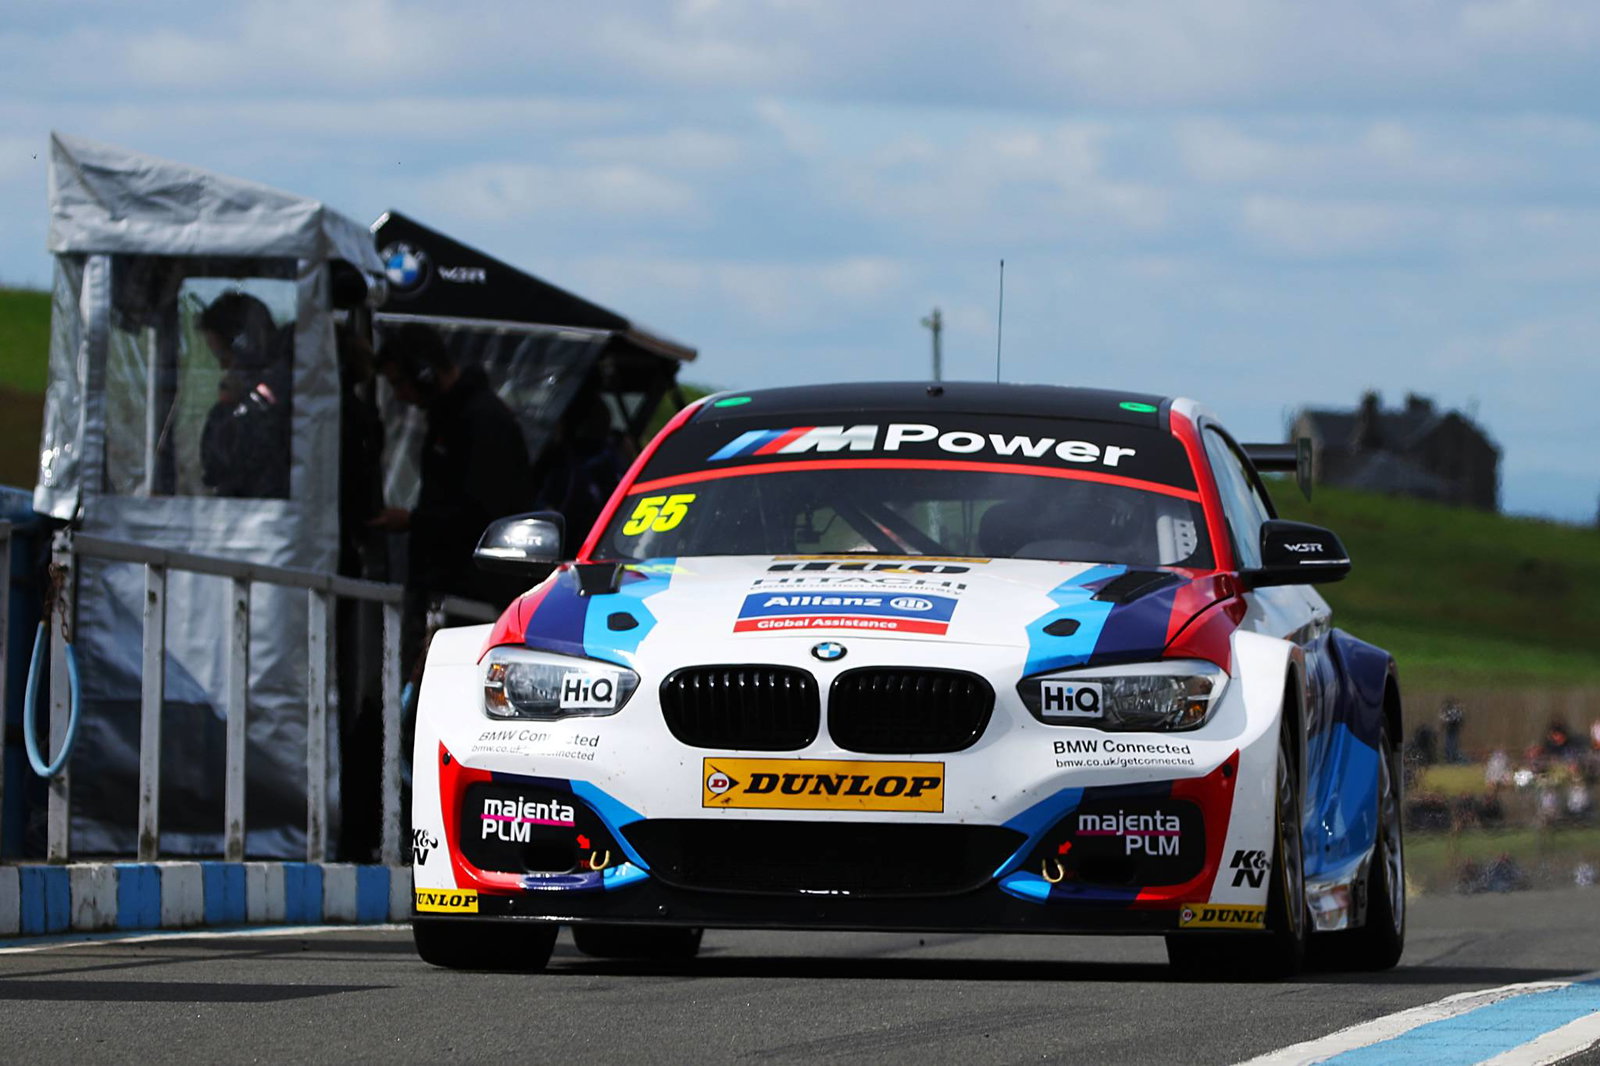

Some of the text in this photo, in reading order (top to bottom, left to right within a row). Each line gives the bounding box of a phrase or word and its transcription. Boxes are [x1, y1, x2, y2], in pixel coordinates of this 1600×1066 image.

[622, 494, 696, 535] 55
[1283, 543, 1324, 552] WSR
[763, 596, 883, 607] Allianz
[757, 618, 898, 629] Global Assistance
[564, 678, 613, 703] HiQ
[1044, 686, 1100, 713] HiQ
[478, 730, 517, 742] BMW
[1053, 739, 1191, 754] BMW Connected
[1056, 757, 1195, 768] bmw.co.uk/getconnected
[743, 773, 941, 797] DUNLOP
[484, 796, 575, 822] majenta
[481, 818, 532, 843] PLM
[1078, 810, 1180, 835] majenta
[1125, 835, 1179, 856] PLM
[417, 893, 478, 908] UNLOP
